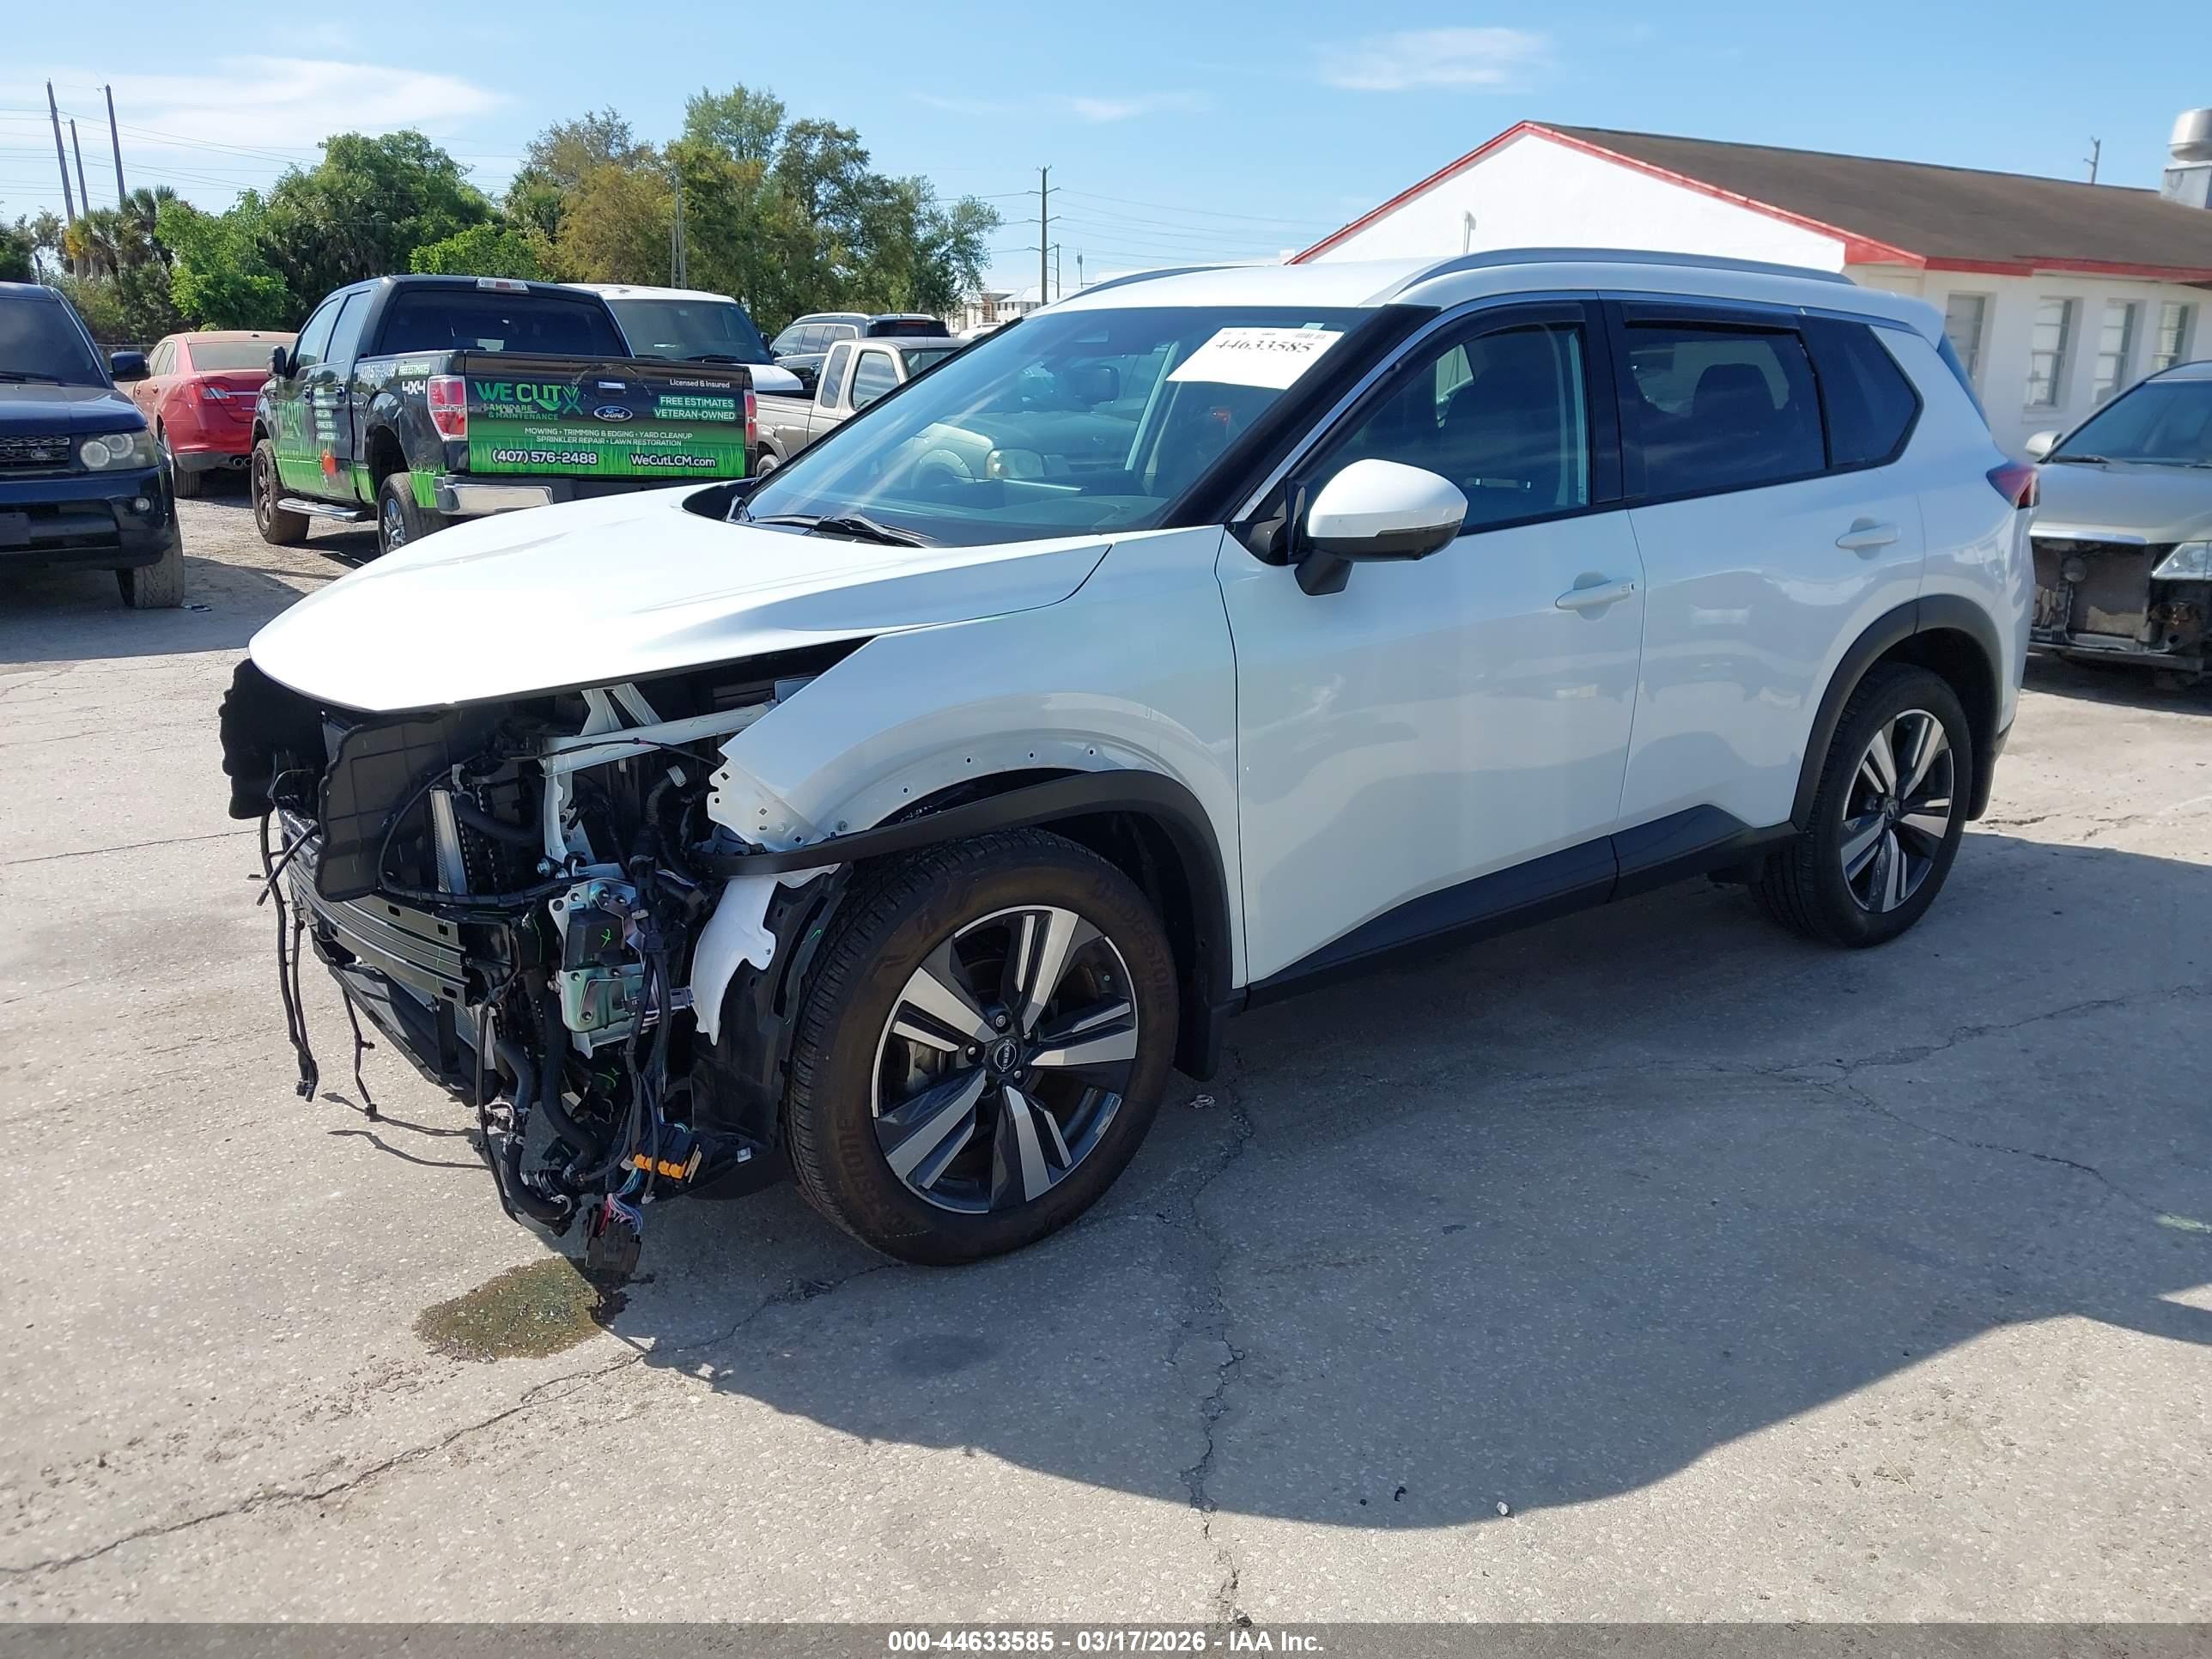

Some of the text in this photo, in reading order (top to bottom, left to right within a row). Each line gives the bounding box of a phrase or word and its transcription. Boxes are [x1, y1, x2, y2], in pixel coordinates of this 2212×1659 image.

[1216, 340, 1315, 353] 44633585
[402, 380, 426, 394] 4X4
[474, 381, 562, 409] WE CUT
[659, 396, 734, 408] FREE ESTIMATES
[654, 408, 736, 420] VETERAN-OWNED
[525, 427, 558, 435] MOWING
[563, 428, 599, 437] TRIMMING
[633, 438, 682, 447] RESTORATION
[492, 449, 598, 464] (407) 576-2488
[629, 453, 715, 467] WeCutLCM.com
